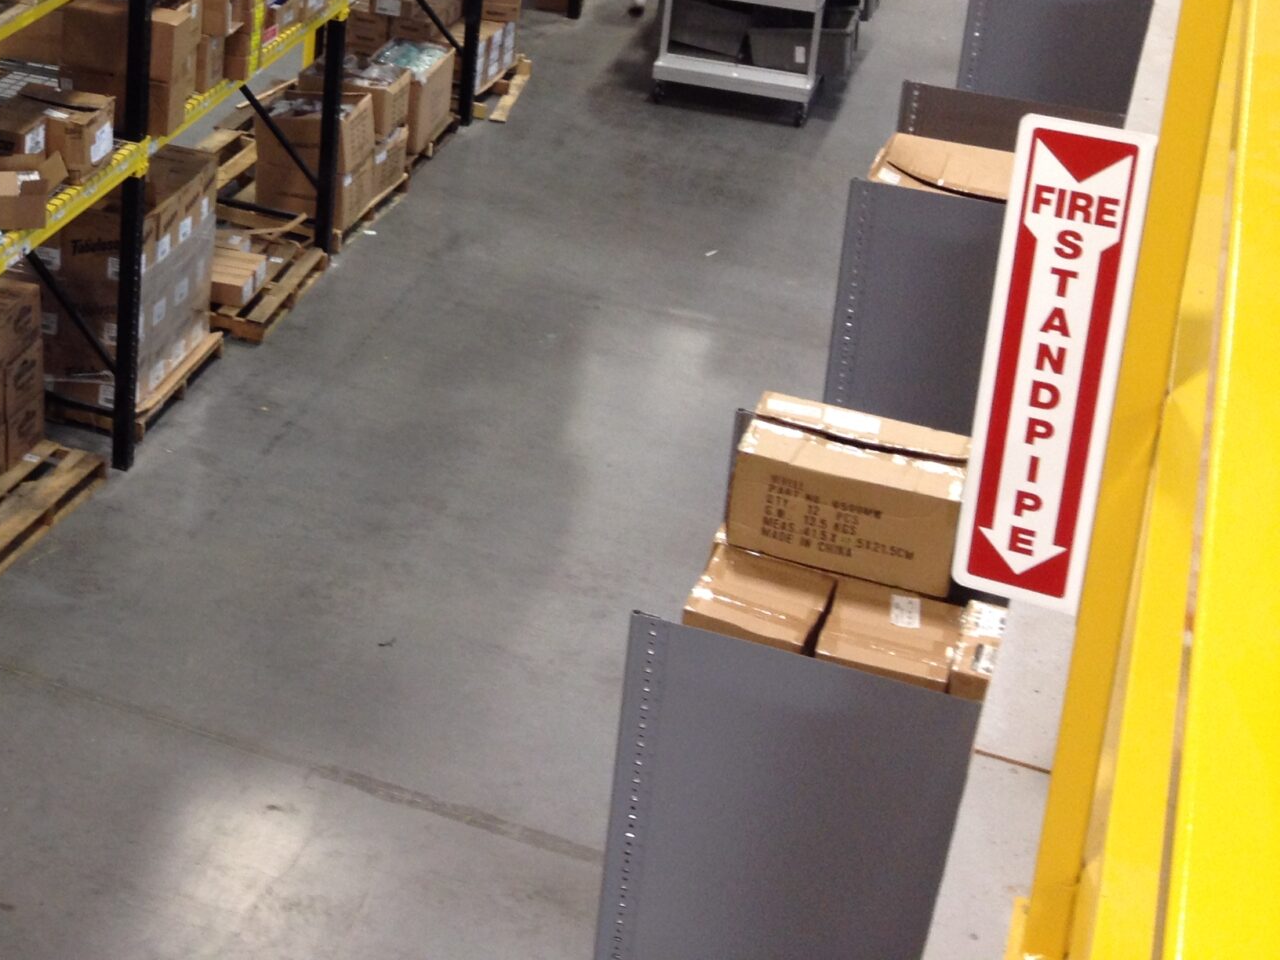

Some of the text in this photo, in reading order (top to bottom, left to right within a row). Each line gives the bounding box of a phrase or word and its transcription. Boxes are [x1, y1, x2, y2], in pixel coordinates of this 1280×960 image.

[1031, 183, 1120, 228] FIRE
[1007, 229, 1084, 556] STANDPIPE
[761, 527, 794, 544] MADE
[817, 541, 853, 558] CHINA
